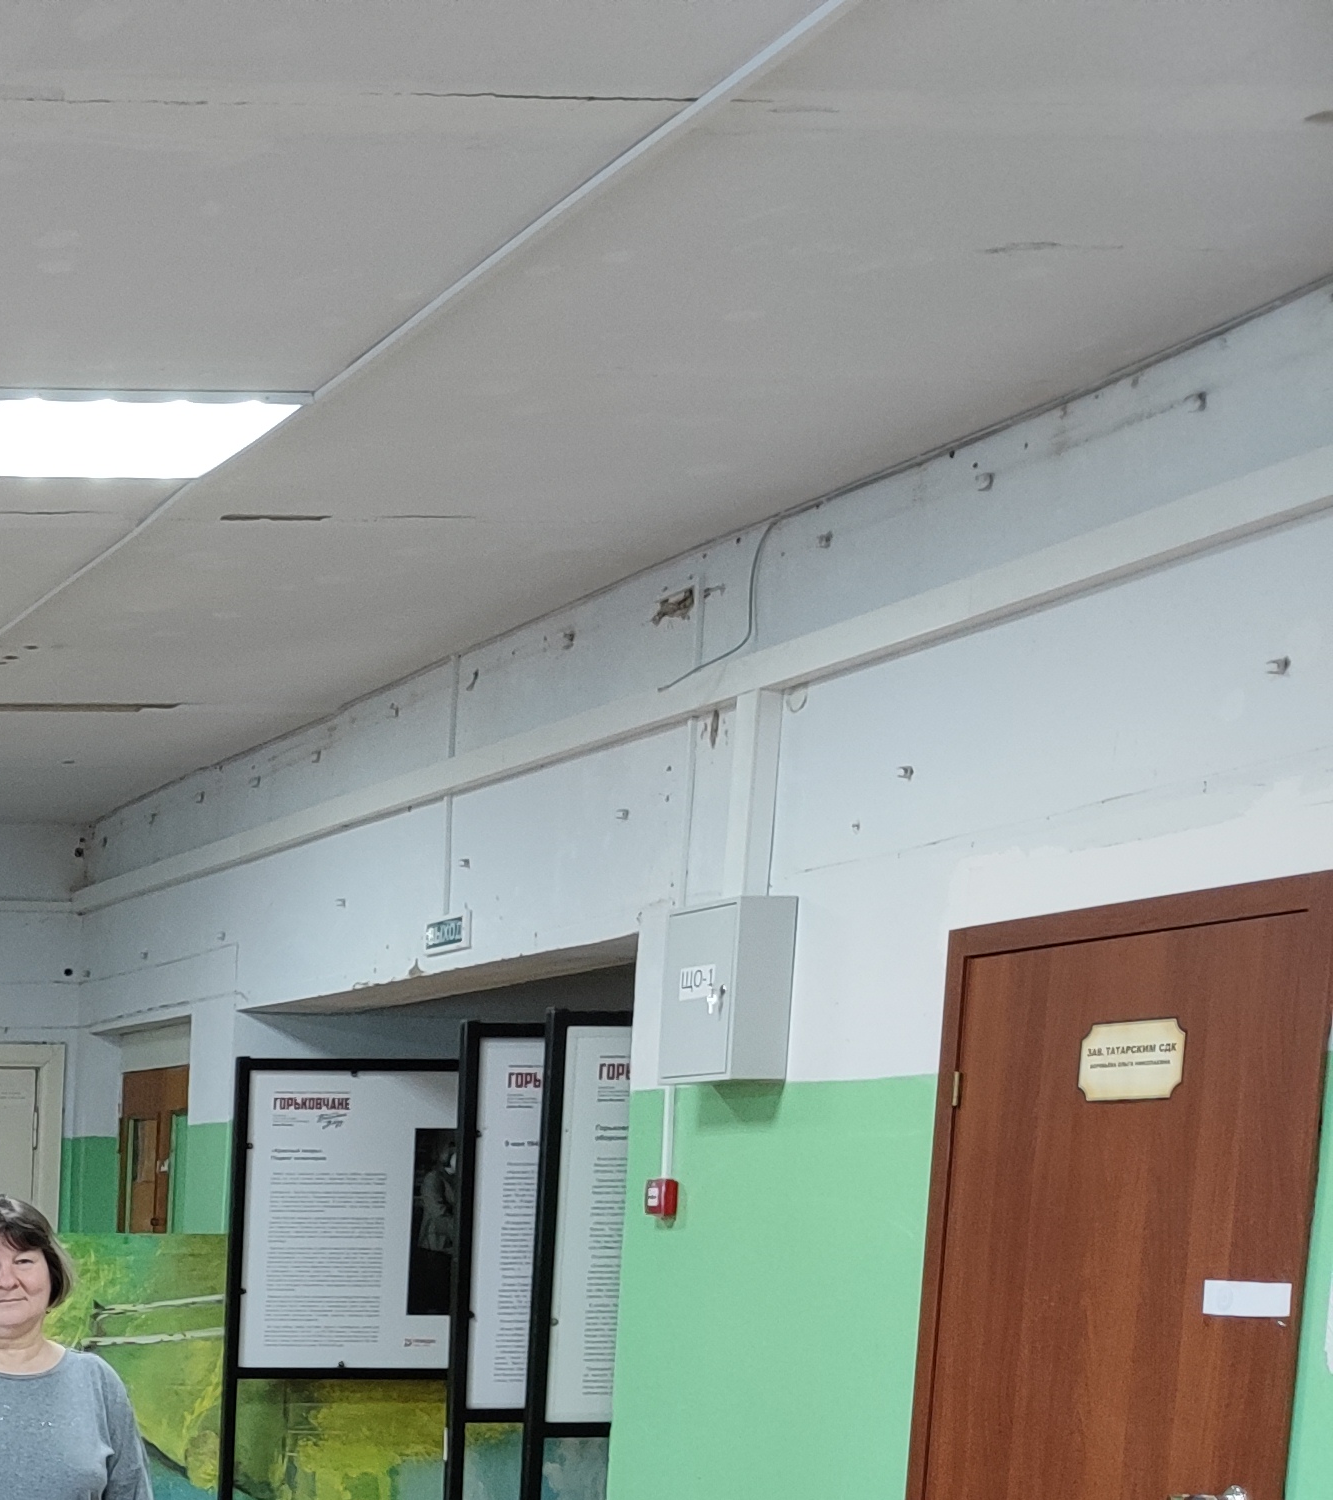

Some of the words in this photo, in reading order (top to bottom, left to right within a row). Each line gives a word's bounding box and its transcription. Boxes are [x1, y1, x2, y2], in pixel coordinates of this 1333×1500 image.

[681, 968, 713, 992] ЩО-1
[1106, 1045, 1156, 1055] ТАТАРСКИМ
[1159, 1042, 1177, 1053] СДК
[273, 1097, 351, 1111] ГОРЬКОВЧАНЕ
